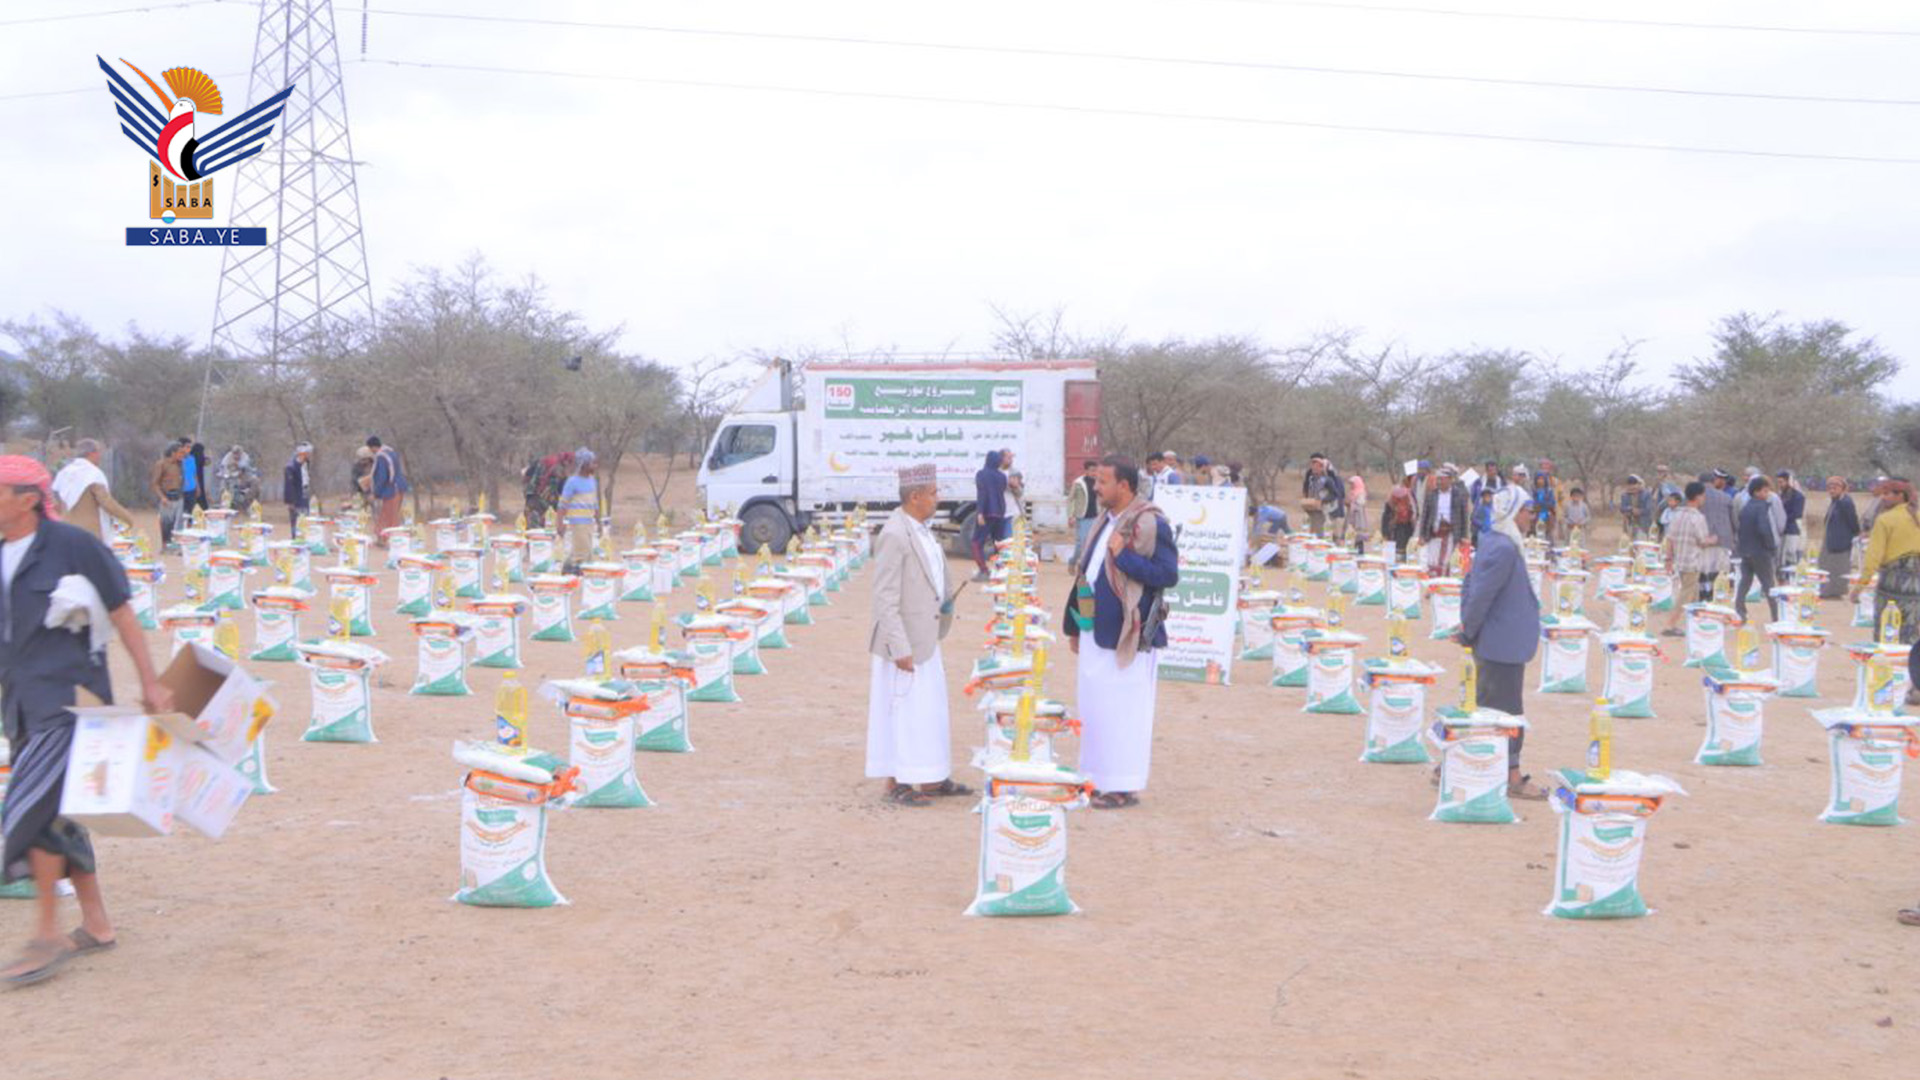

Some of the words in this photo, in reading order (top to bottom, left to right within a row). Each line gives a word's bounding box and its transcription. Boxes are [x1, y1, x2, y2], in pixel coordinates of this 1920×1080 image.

[828, 386, 852, 397] 150
[875, 384, 924, 398] توزيع
[879, 426, 913, 443] خير
[917, 427, 963, 443] فاعل
[1183, 590, 1225, 608] فاعل
